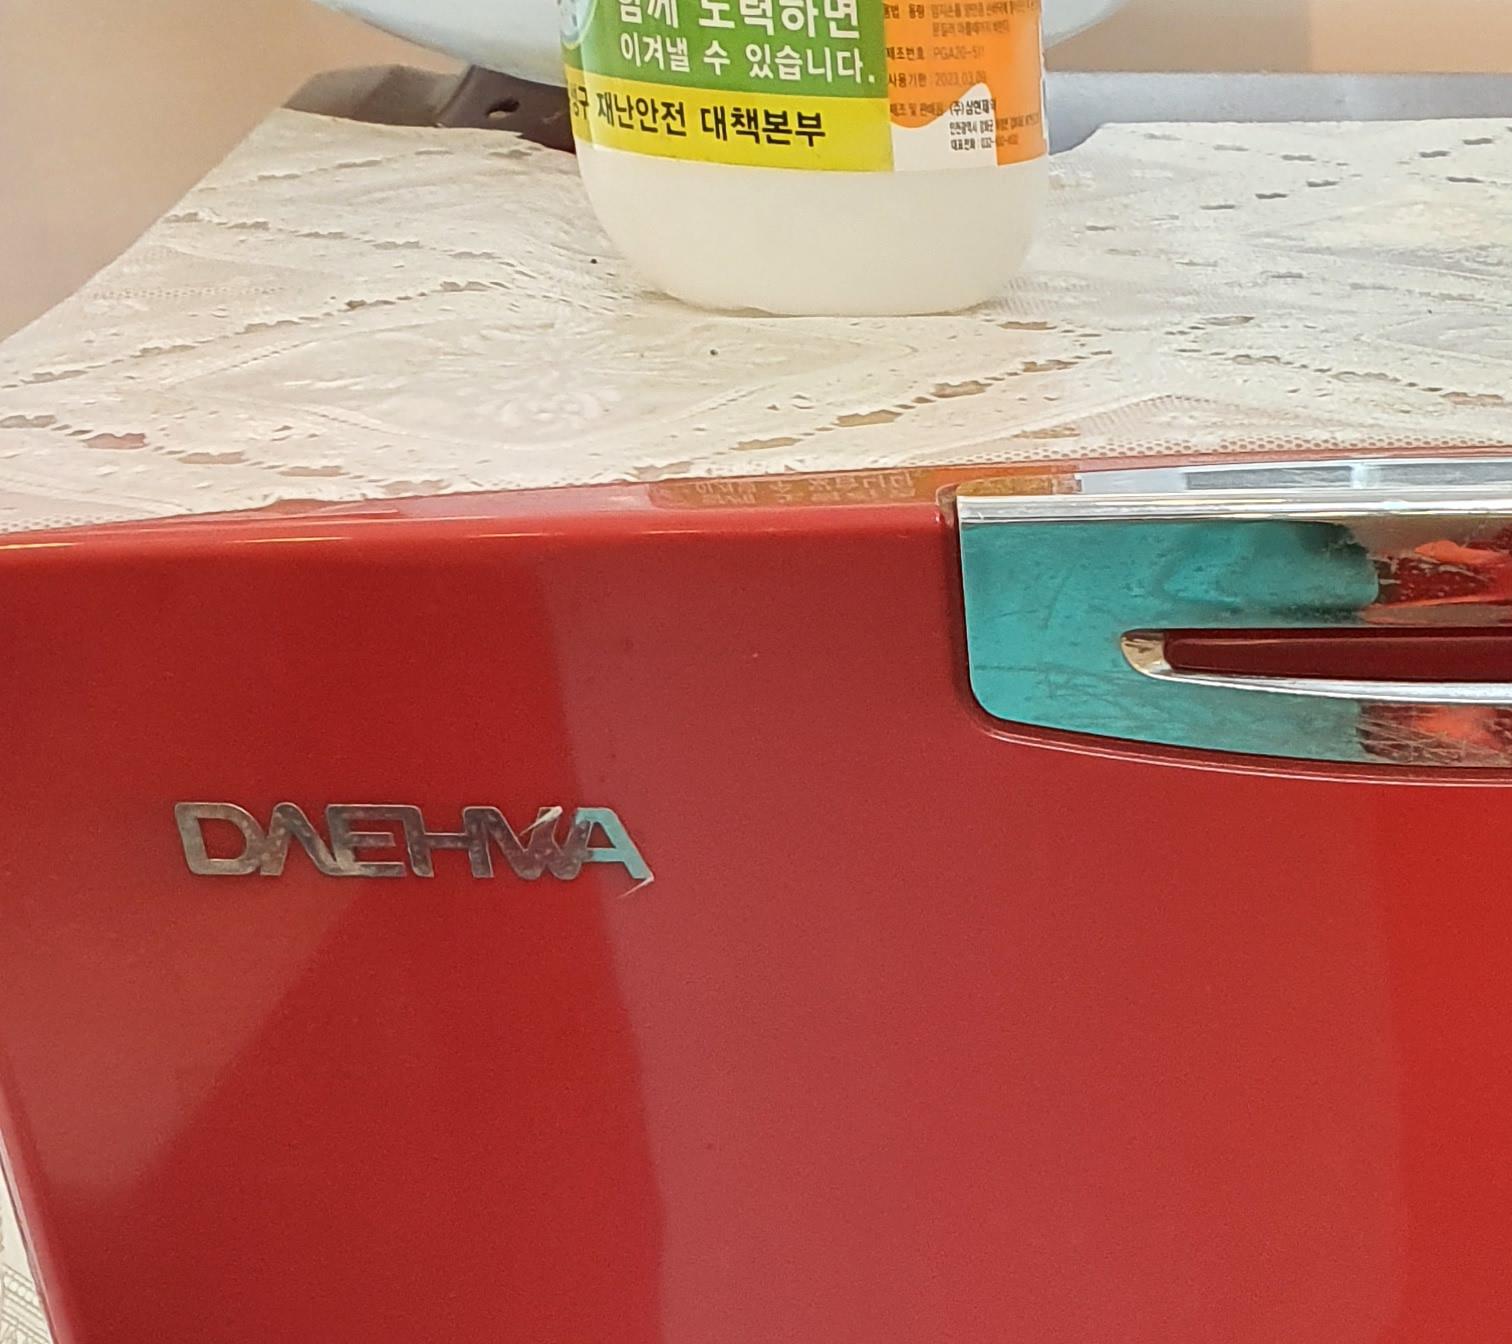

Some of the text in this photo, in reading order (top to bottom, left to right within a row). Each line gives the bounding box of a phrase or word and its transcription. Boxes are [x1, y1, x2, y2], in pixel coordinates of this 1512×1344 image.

[620, 32, 875, 83] 이겨낼 수 있습니다.
[596, 91, 687, 137] 재난안전
[700, 106, 825, 147] 대책본부
